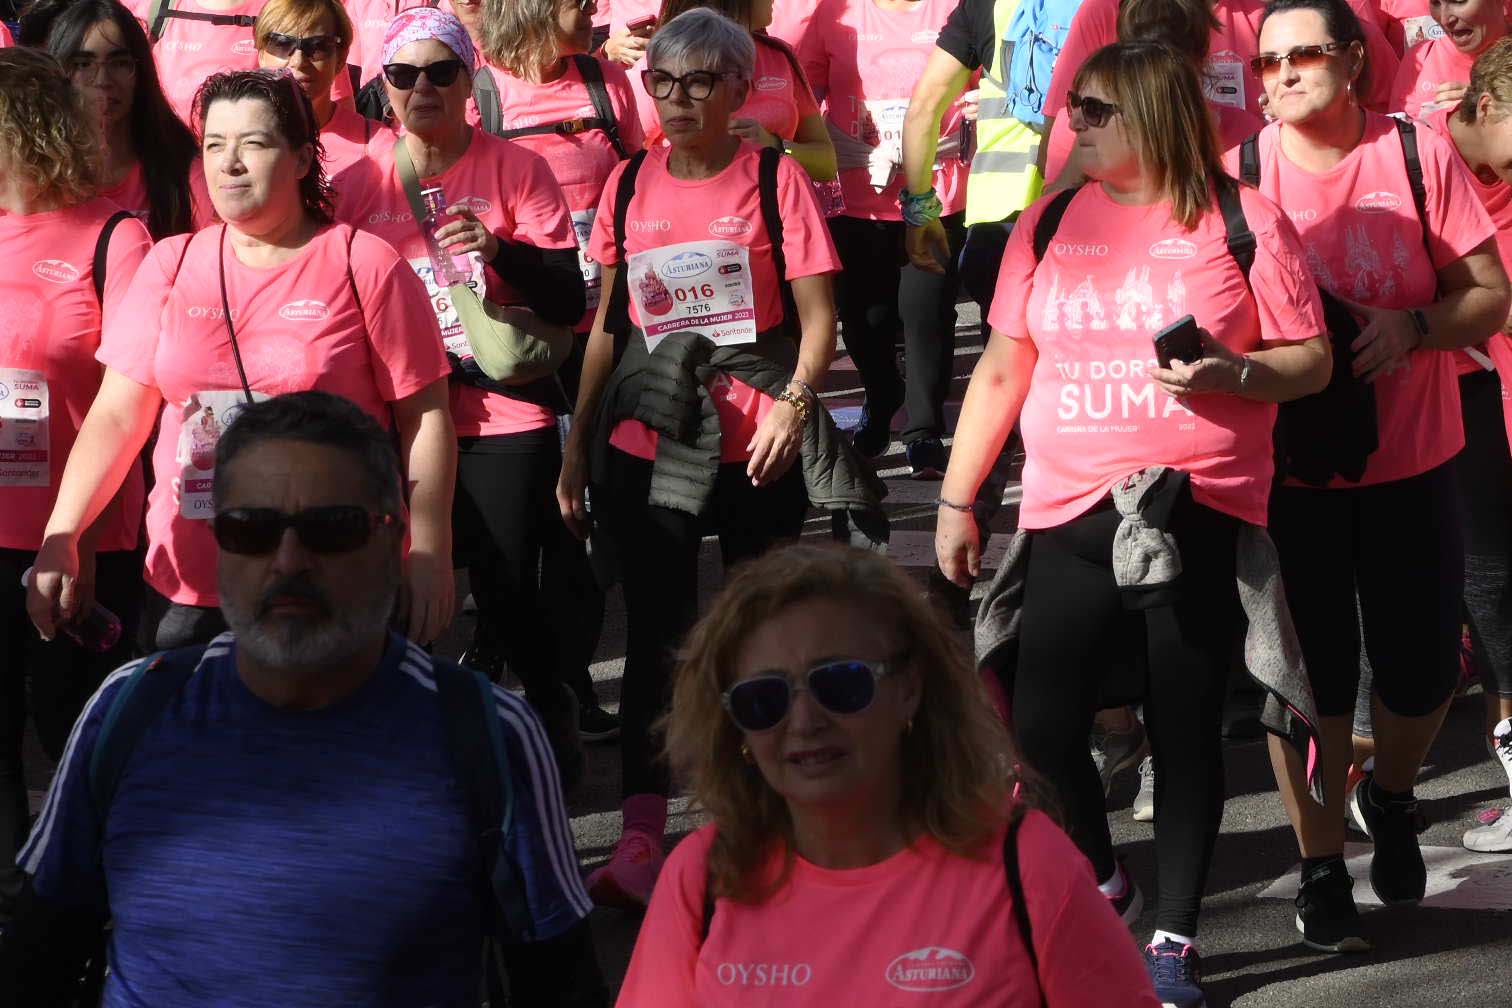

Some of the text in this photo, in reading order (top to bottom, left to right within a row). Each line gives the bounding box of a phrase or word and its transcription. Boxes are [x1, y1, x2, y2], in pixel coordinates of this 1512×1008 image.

[631, 220, 671, 232] OYSHO
[1055, 242, 1109, 257] OYSHO
[666, 260, 709, 276] ASTURIANA
[674, 283, 714, 302] 016
[686, 303, 711, 315] 7576
[657, 320, 690, 332] CARRERA
[1056, 362, 1080, 381] TU
[14, 383, 39, 391] SUMA
[717, 962, 813, 985] OYSHO
[893, 965, 969, 982] ASTURIANA
